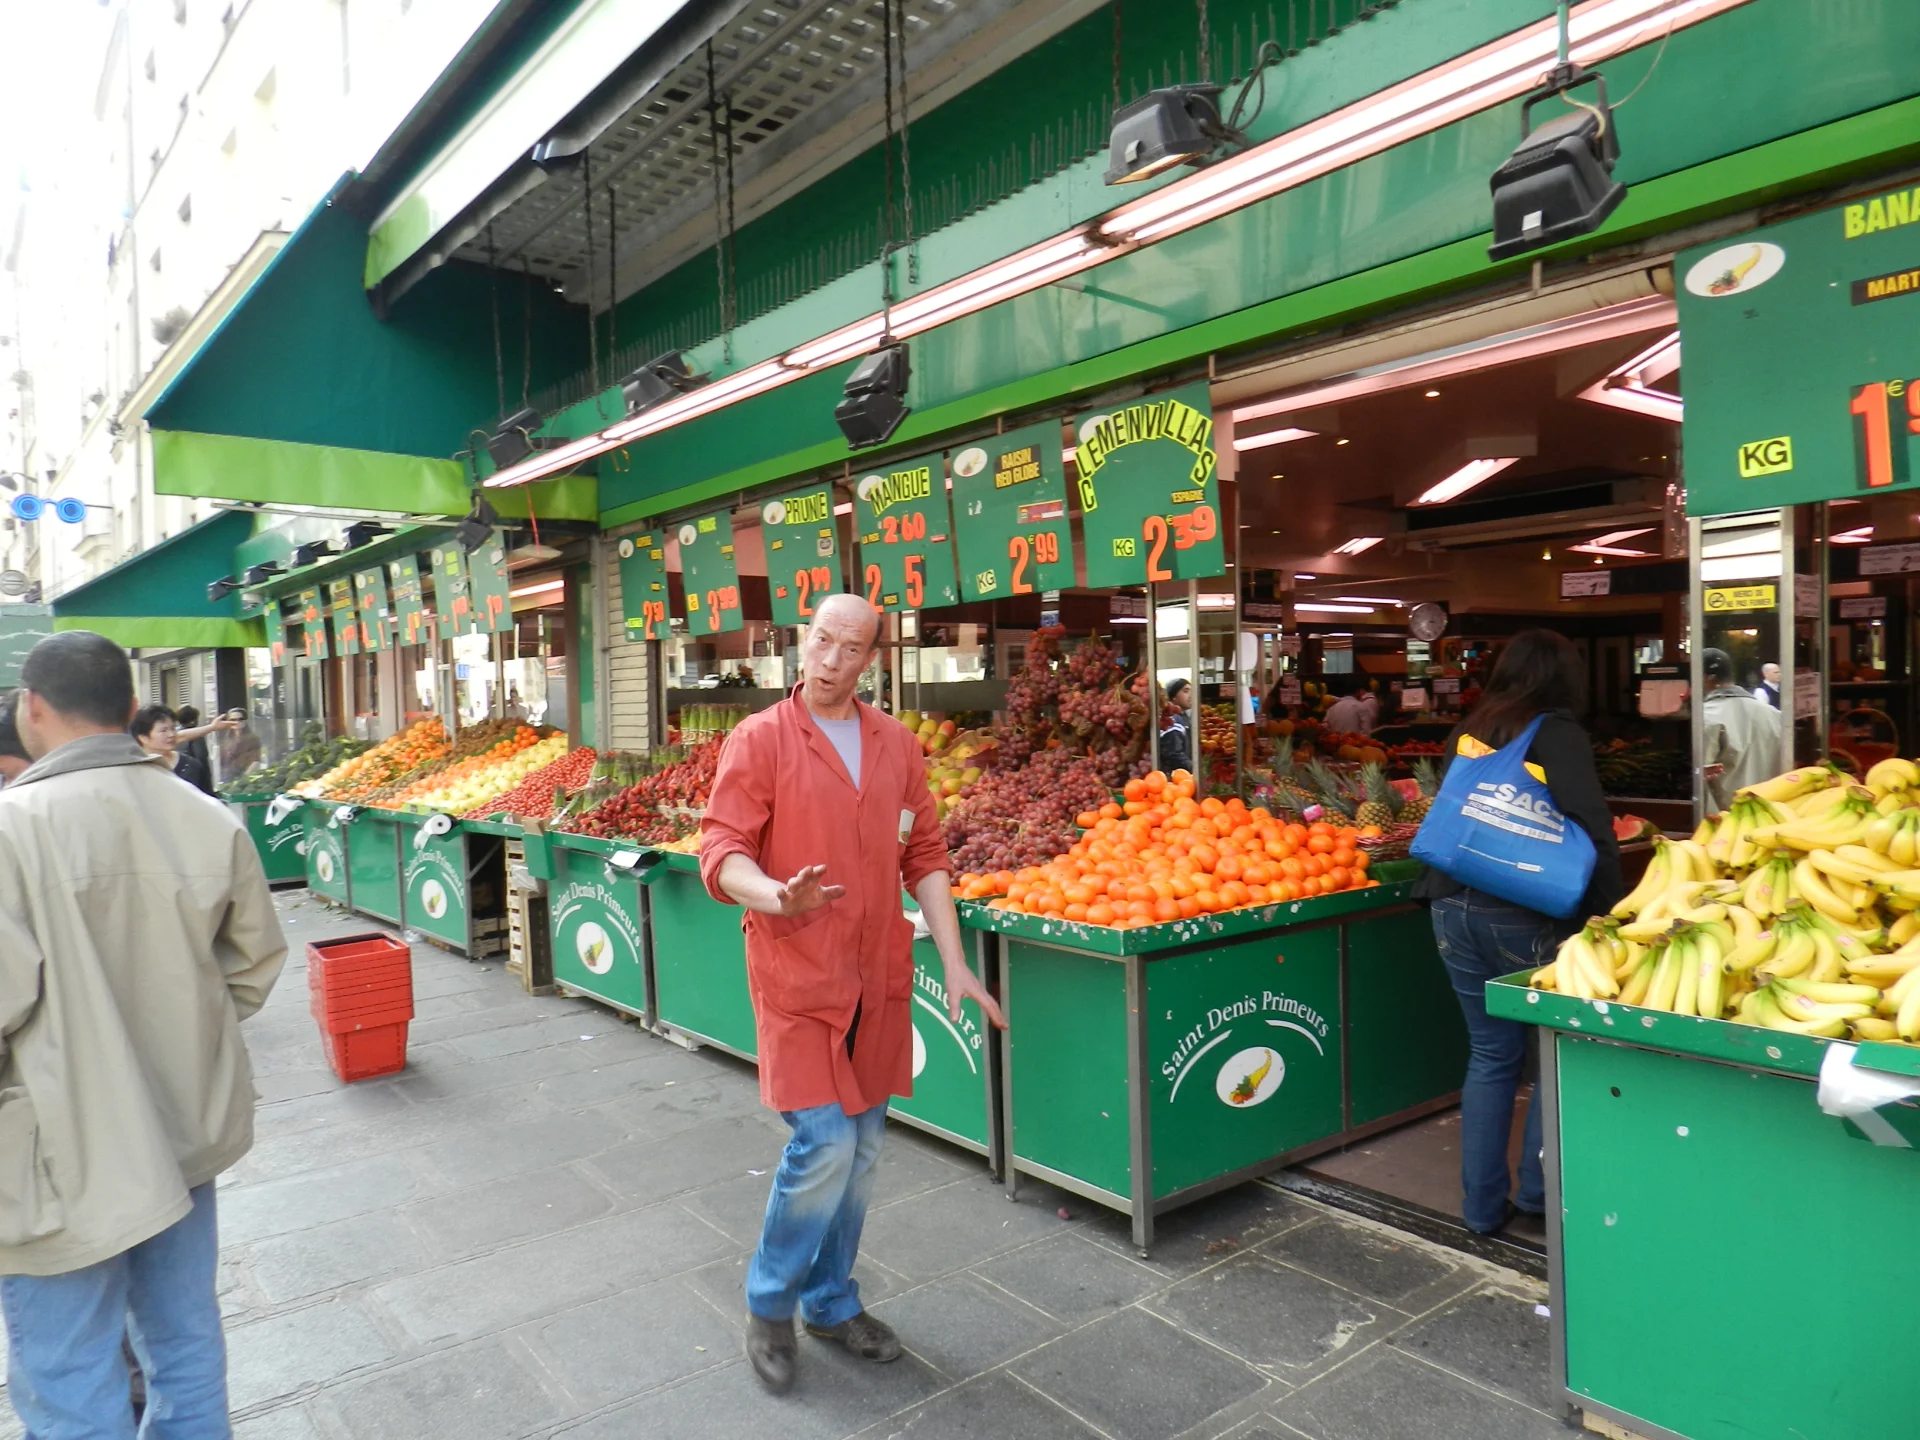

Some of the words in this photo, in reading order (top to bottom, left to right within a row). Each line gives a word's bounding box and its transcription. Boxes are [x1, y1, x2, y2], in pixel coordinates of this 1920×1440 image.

[1001, 448, 1031, 470] RAISIN
[1743, 440, 1789, 471] KG
[995, 470, 1014, 488] RED
[1013, 462, 1040, 484] GLOBE
[869, 467, 930, 515] MANGUE
[785, 491, 828, 524] PRUNE
[1116, 540, 1134, 555] KG
[977, 571, 997, 592] KG
[1162, 1023, 1206, 1081] Saint
[1206, 995, 1257, 1031] Denis
[1262, 990, 1330, 1037] Primeurs
